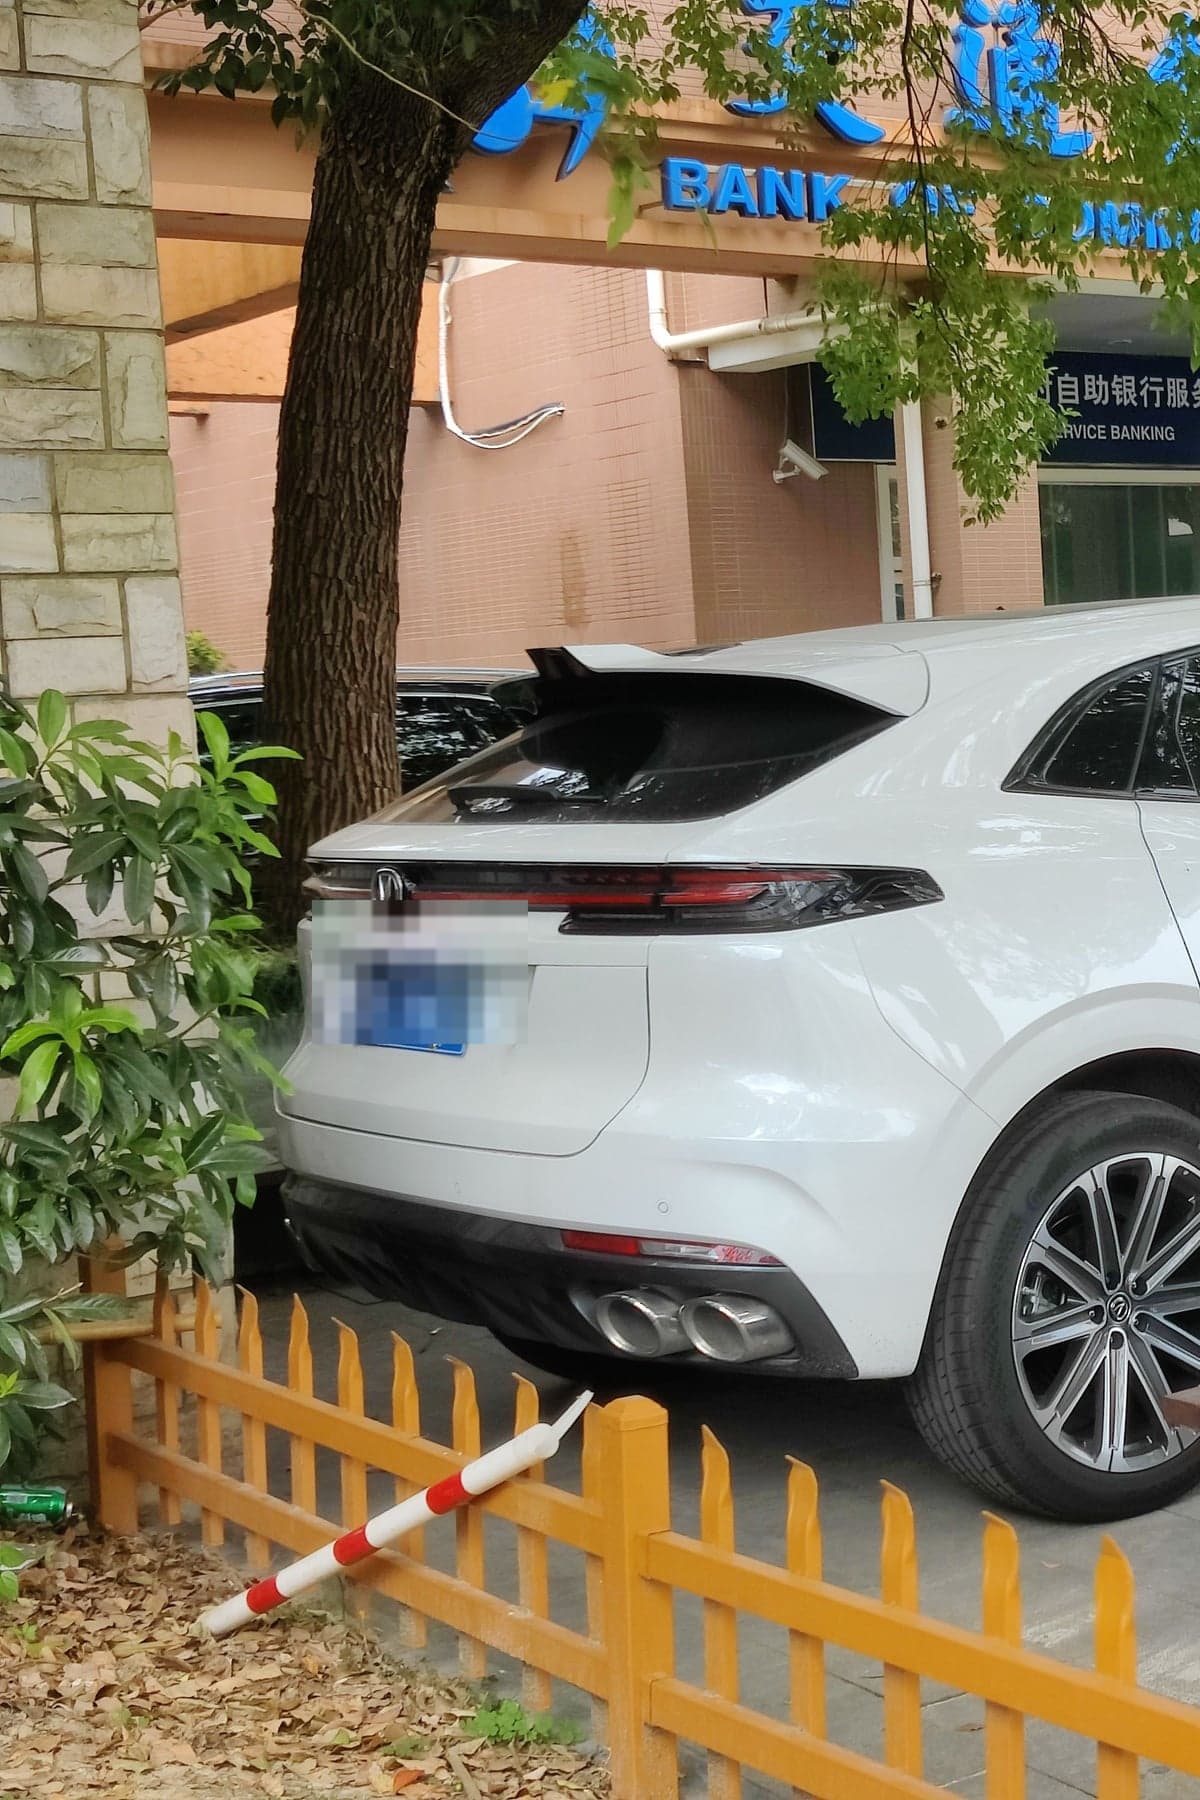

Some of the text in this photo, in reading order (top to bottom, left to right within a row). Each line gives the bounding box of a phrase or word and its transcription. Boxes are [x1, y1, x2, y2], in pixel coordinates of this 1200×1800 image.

[662, 156, 852, 223] BANK
[1054, 424, 1176, 441] RVICE BANKING
